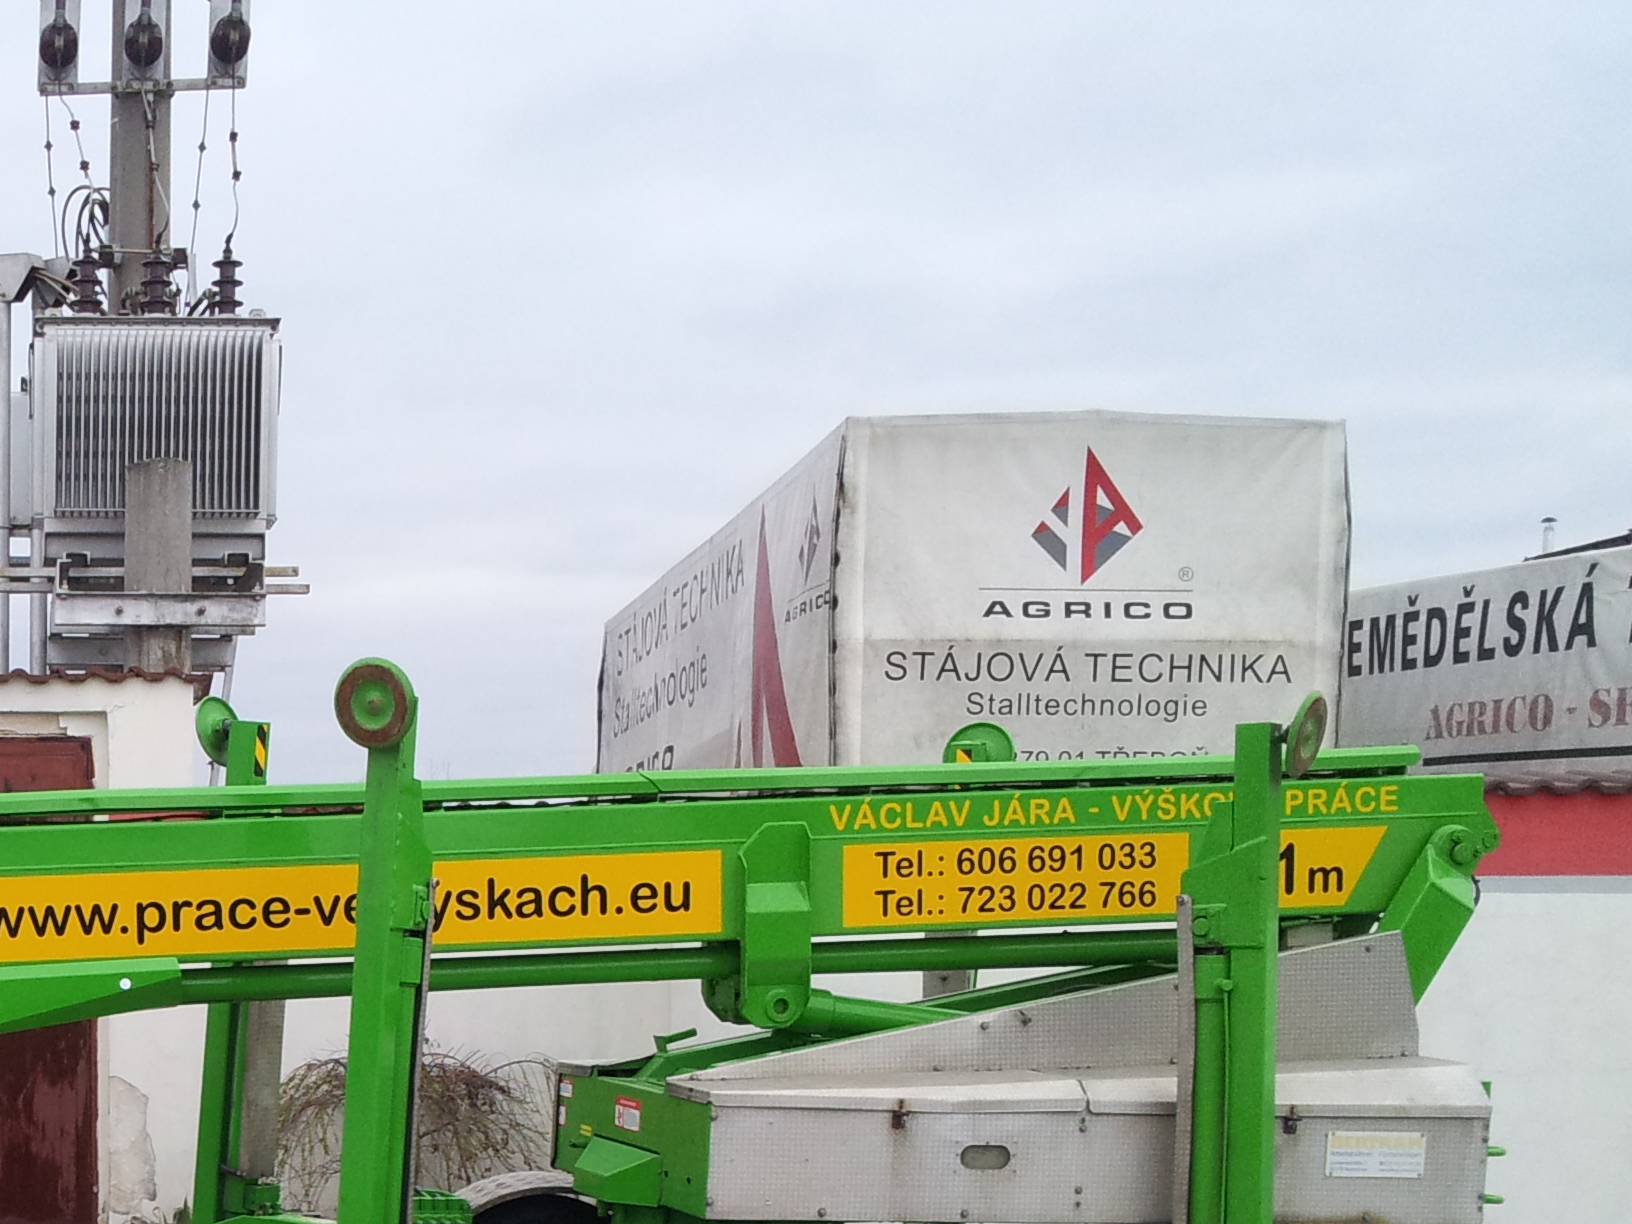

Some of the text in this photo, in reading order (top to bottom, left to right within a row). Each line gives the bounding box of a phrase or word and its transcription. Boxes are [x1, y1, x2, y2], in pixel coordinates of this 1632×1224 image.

[784, 589, 832, 623] AGRICO
[981, 599, 1194, 620] AGRICO
[1346, 562, 1599, 678] EMĚDĚLSKÁ
[883, 644, 1294, 685] STÁJOVÁ TECHNIKA
[965, 690, 1209, 723] Stalltechnologie
[1424, 692, 1555, 741] AGRICO
[829, 796, 971, 832] VÁCLAV
[983, 792, 1077, 828] JÁRA
[1111, 786, 1234, 823] VÝŠKO
[1285, 780, 1400, 816] PRÁCE
[874, 841, 1158, 879] Tel.: 606 691 033
[1279, 841, 1296, 896] 1
[874, 880, 1158, 918] Tel.: 723 022 766
